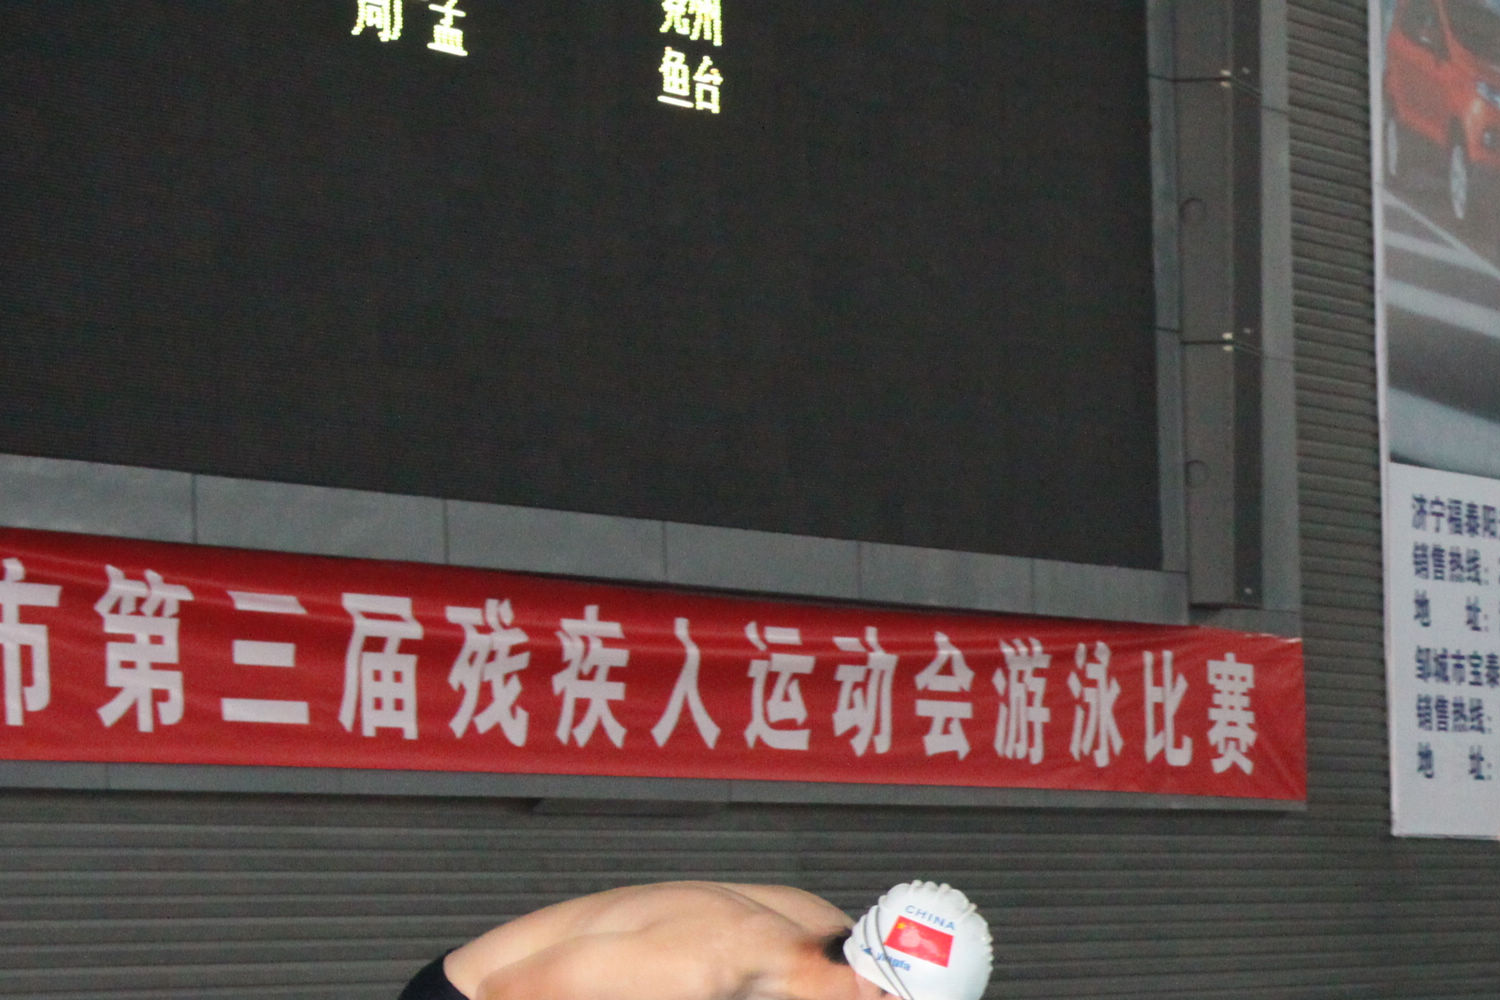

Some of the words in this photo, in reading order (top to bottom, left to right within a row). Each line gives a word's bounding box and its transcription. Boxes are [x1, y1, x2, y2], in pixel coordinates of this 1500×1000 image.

[657, 46, 724, 114] 鱼台
[0, 558, 1258, 774] 市第三届残疾人运动会游泳比赛
[904, 904, 956, 931] CHINA
